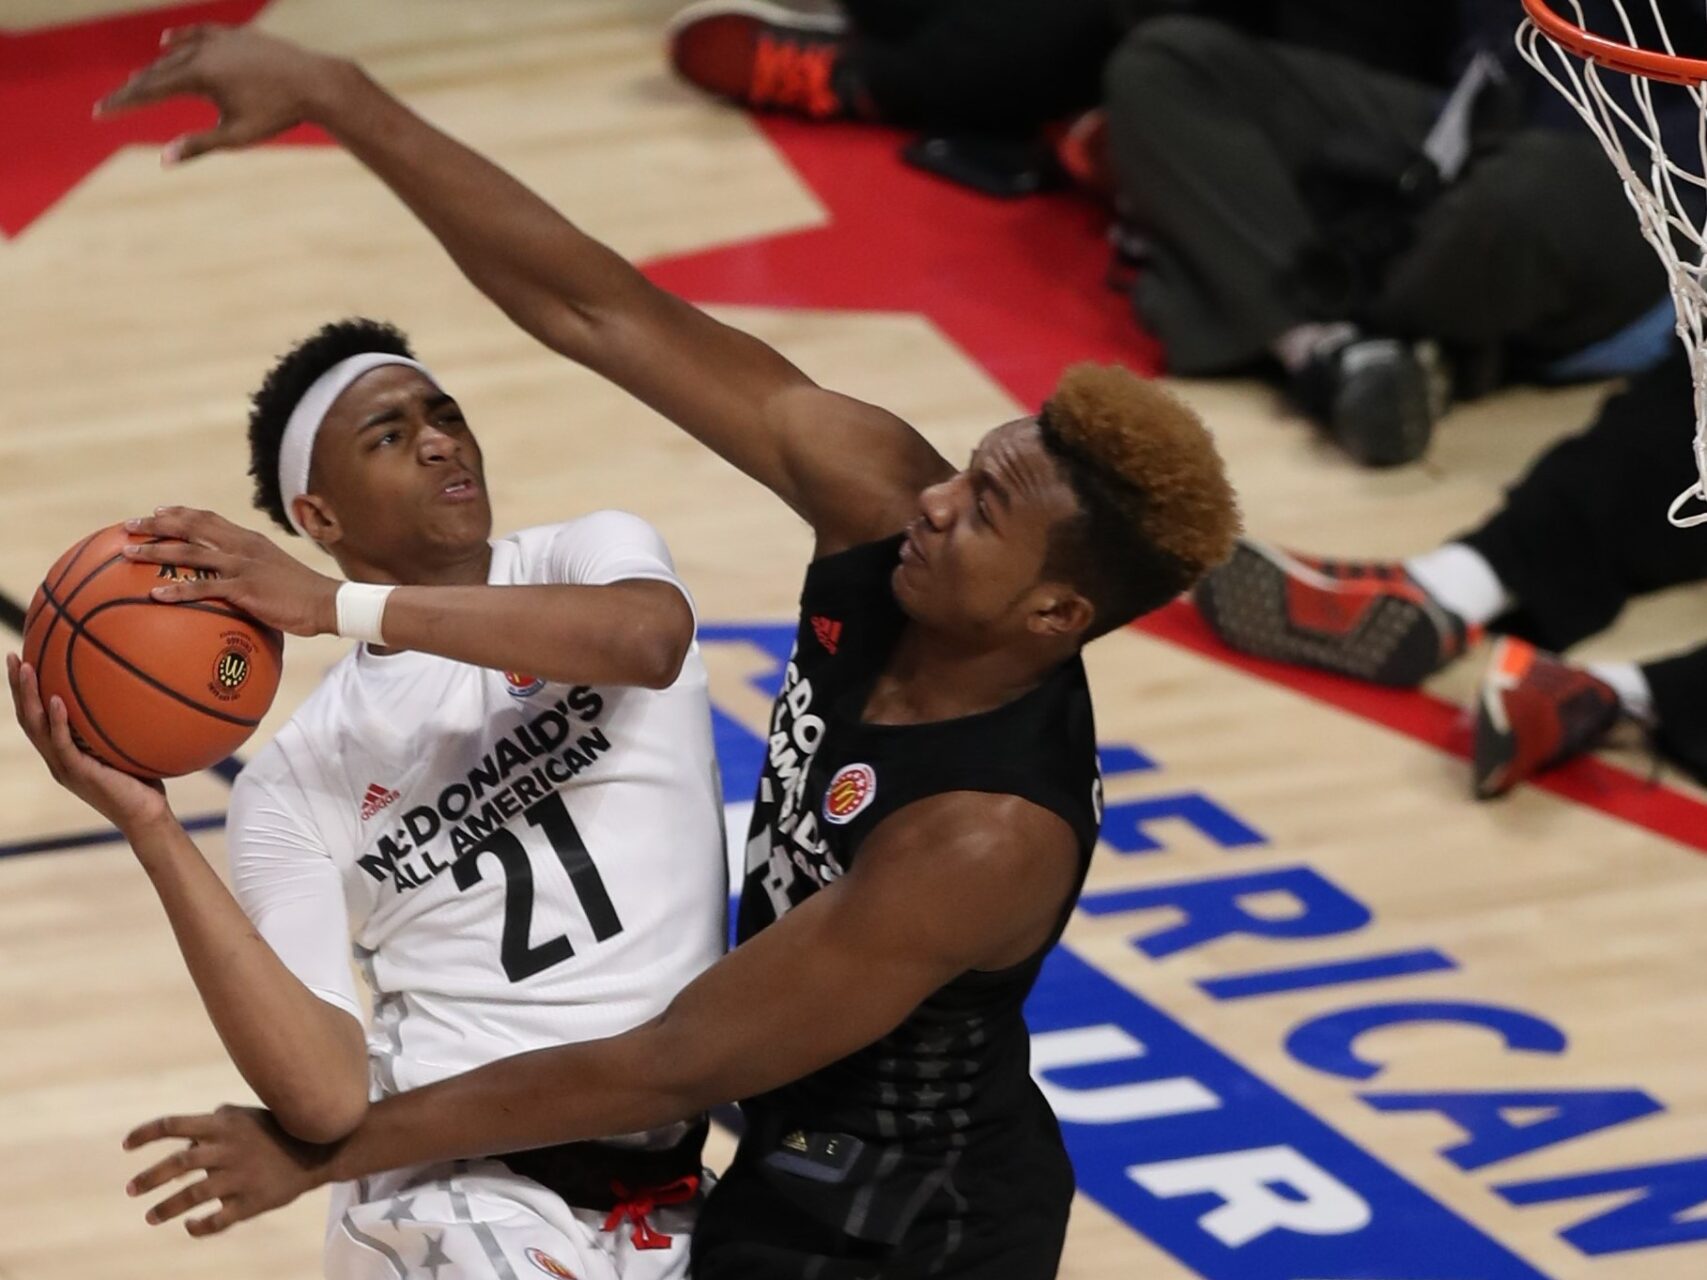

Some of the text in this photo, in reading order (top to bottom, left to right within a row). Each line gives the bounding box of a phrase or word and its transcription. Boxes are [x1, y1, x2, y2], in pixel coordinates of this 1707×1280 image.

[393, 726, 612, 894] ALL AMERICAN
[451, 790, 623, 984] 21
